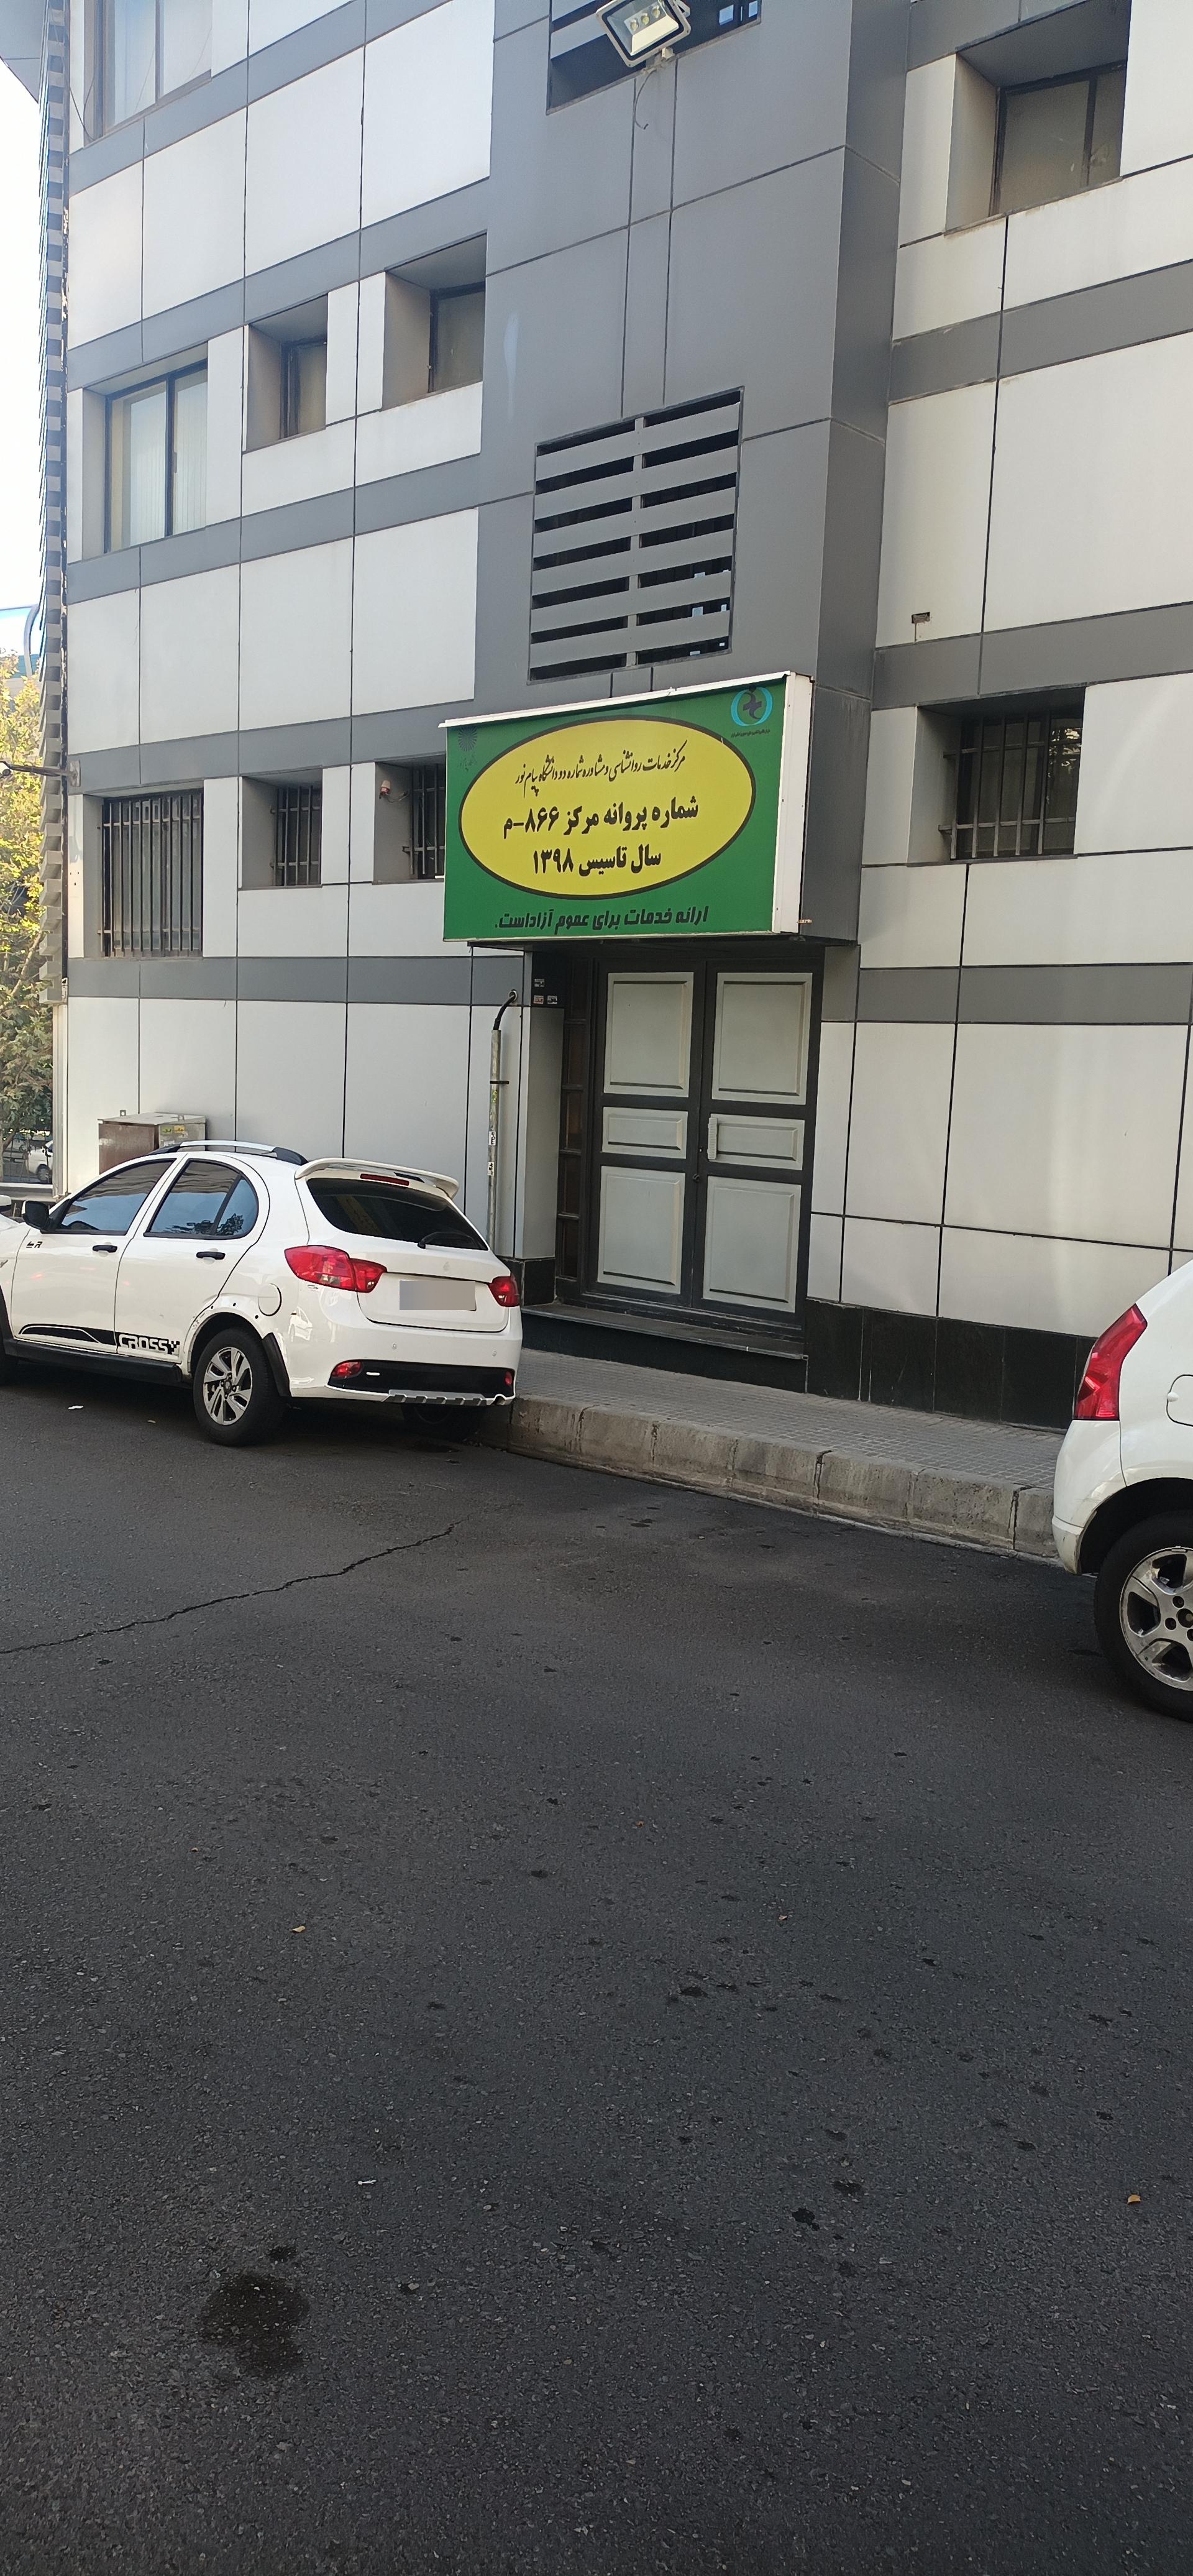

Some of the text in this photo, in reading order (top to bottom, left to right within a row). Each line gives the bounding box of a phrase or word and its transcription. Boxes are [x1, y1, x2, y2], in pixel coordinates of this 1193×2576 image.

[642, 752, 672, 771] خدمات
[670, 739, 688, 772] مرکز
[514, 763, 526, 784] نور
[523, 768, 539, 799] پیام
[563, 805, 600, 836] مرکز
[603, 802, 647, 831] پروانه
[651, 795, 698, 828] شماره
[533, 843, 662, 877] سال تاسیس ۱۳۹۸
[554, 914, 590, 935] عموم
[592, 910, 621, 930] برای
[623, 907, 671, 925] خدمات
[675, 905, 710, 925] ارائه
[119, 1334, 168, 1354] CROSS
